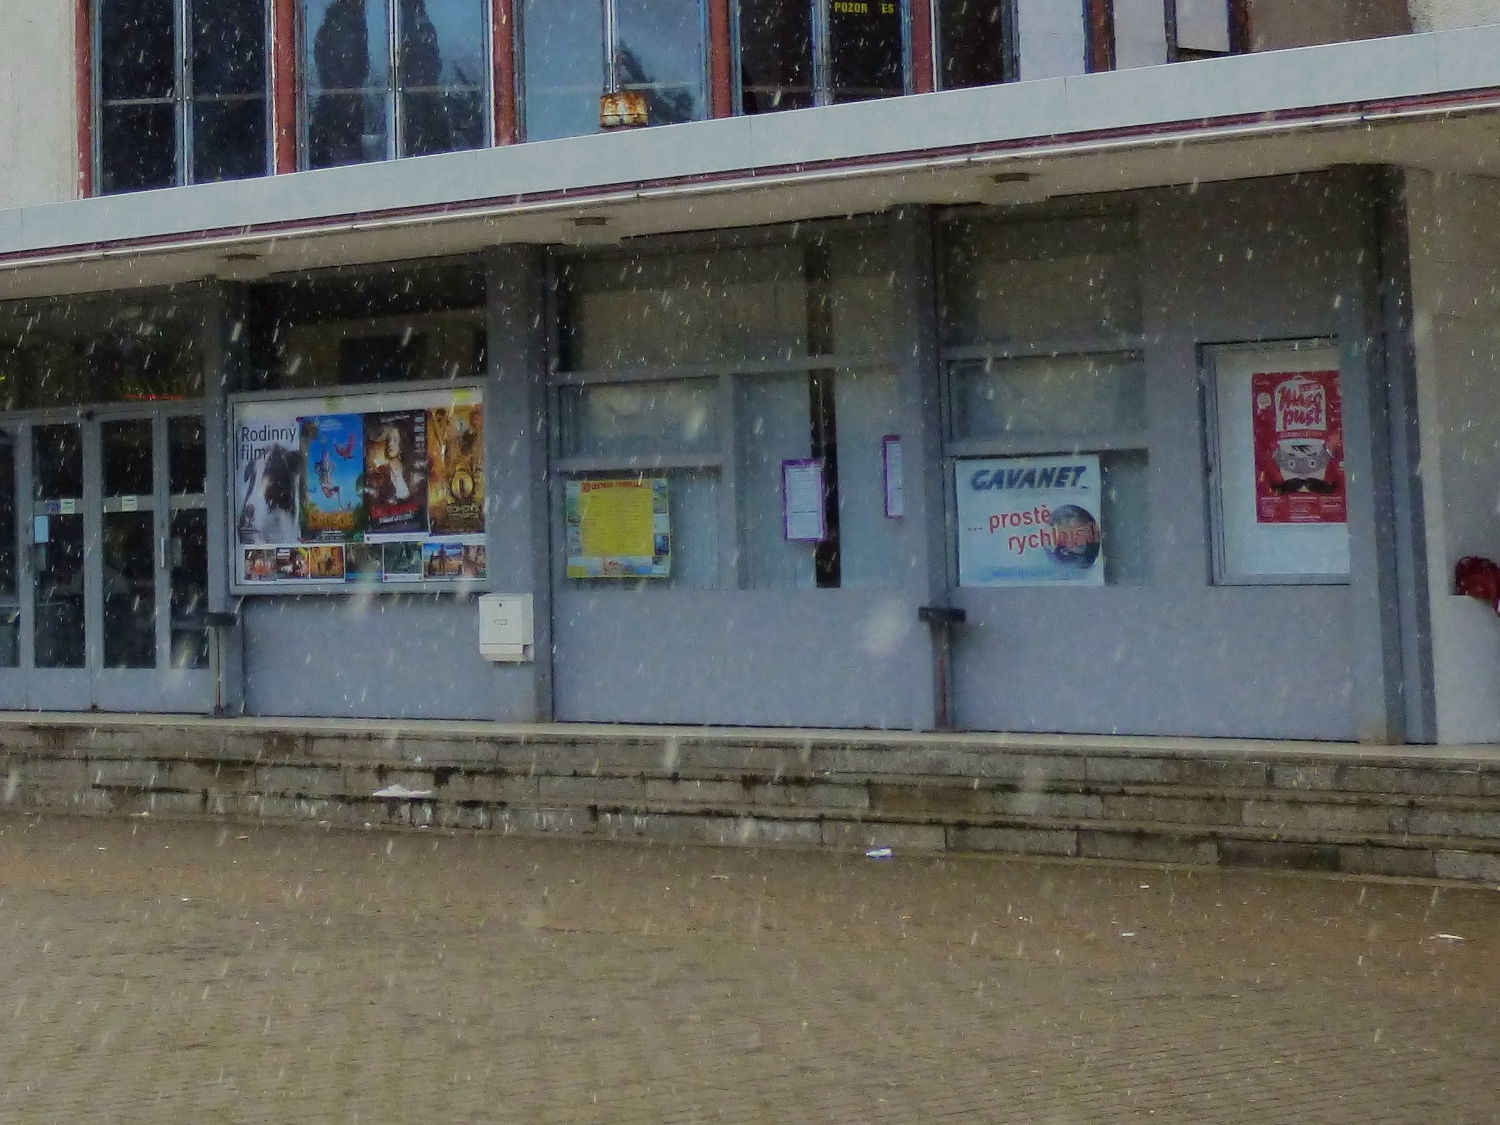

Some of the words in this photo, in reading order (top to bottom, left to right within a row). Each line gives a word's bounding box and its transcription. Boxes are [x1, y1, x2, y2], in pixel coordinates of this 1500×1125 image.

[834, 2, 868, 13] POZOR
[241, 423, 297, 444] Rodinný
[241, 443, 266, 461] film
[989, 504, 1052, 534] prostě
